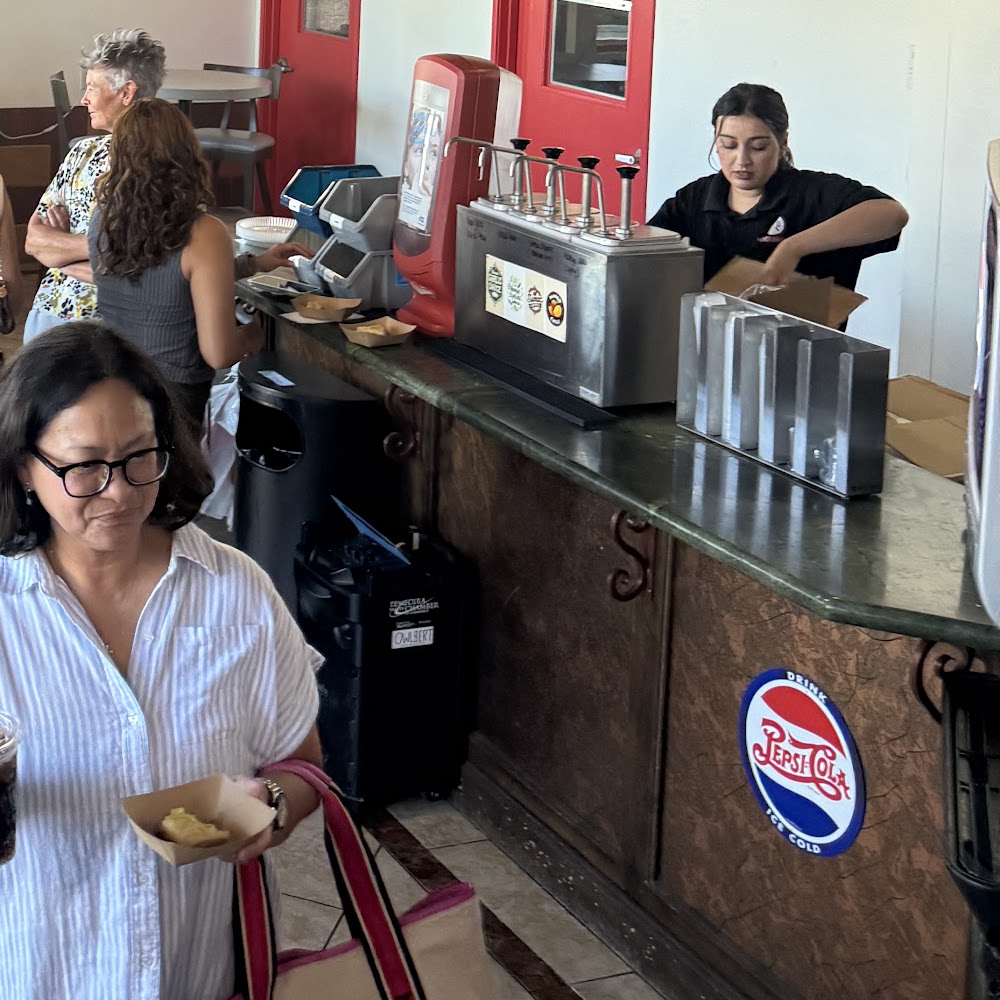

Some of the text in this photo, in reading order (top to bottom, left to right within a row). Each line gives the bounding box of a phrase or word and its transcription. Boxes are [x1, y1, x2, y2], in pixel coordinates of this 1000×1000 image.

[394, 628, 434, 645] OWLBERT
[786, 671, 829, 704] DRINK
[765, 808, 784, 834] ICE
[788, 833, 822, 855] COLD
